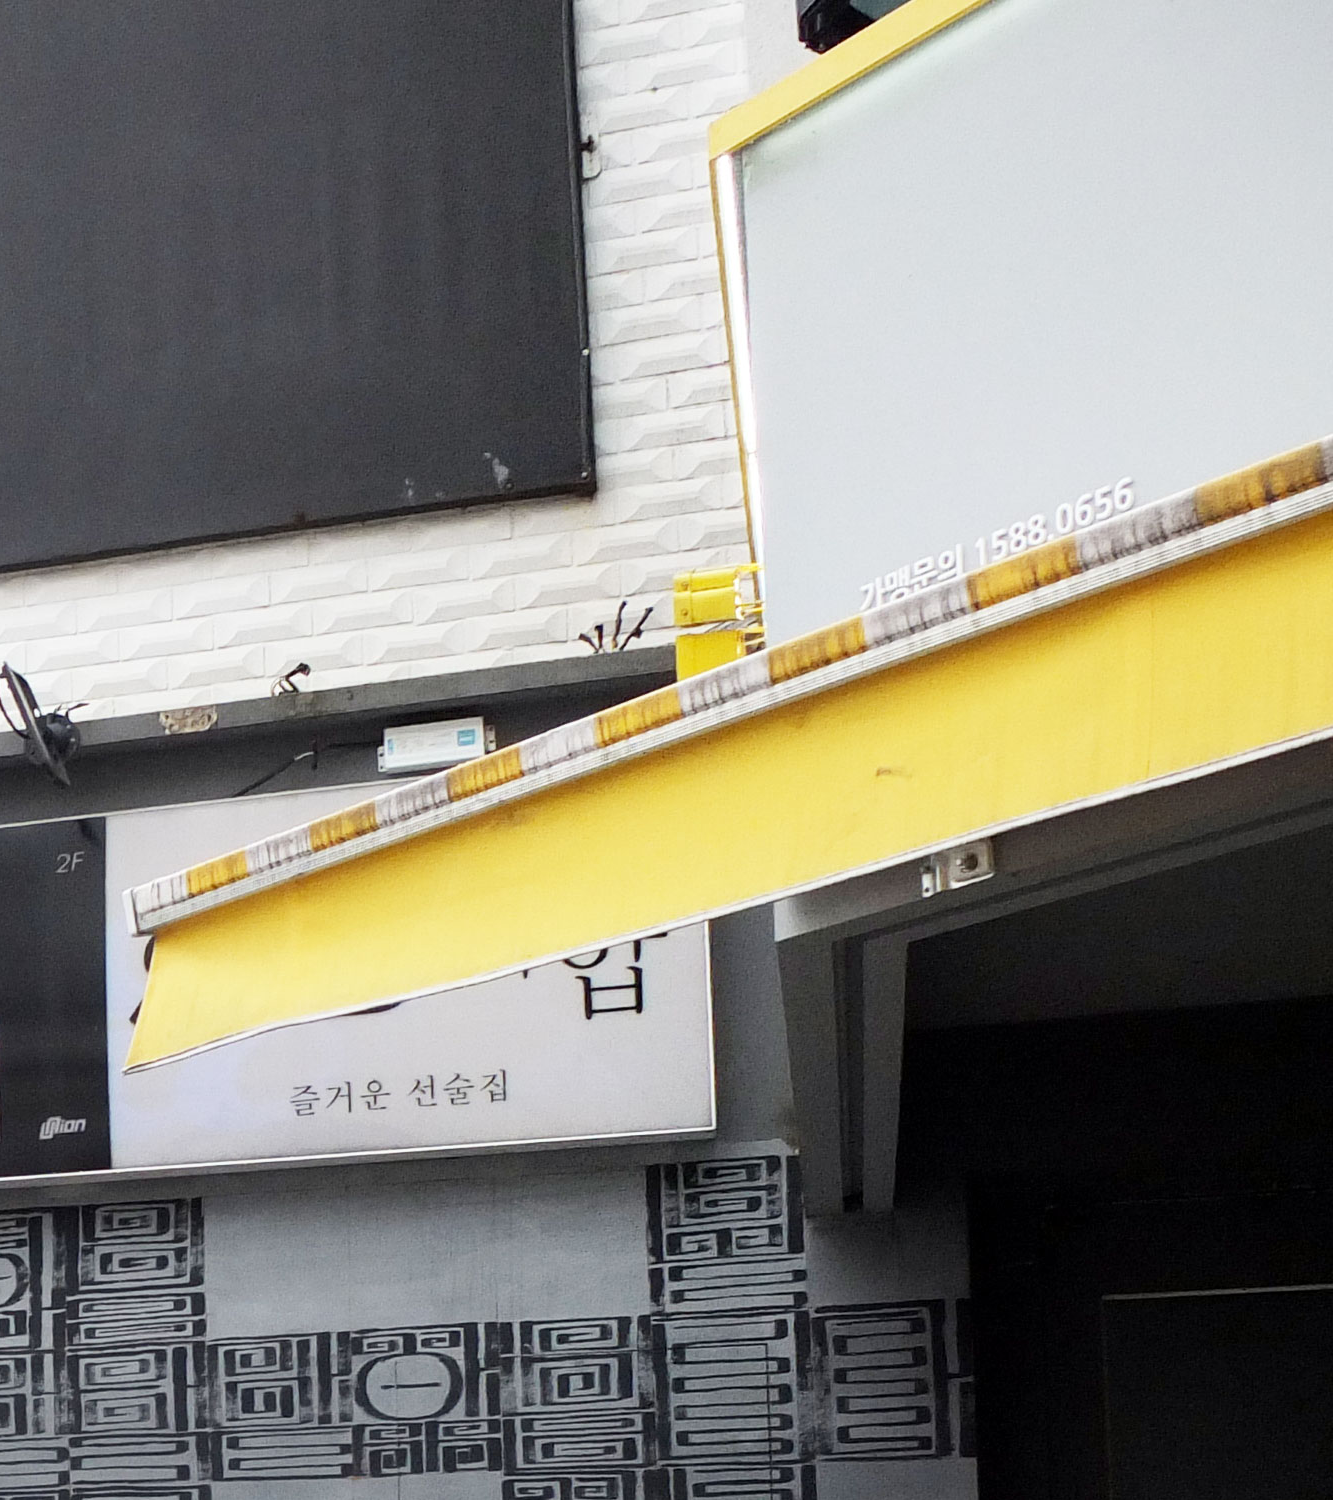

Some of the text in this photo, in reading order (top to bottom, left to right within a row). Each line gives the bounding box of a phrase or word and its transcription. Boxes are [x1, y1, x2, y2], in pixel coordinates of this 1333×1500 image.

[974, 477, 1134, 566] 1588.0656
[55, 851, 85, 874] 2F
[289, 1069, 510, 1117] 즐거운 선술집
